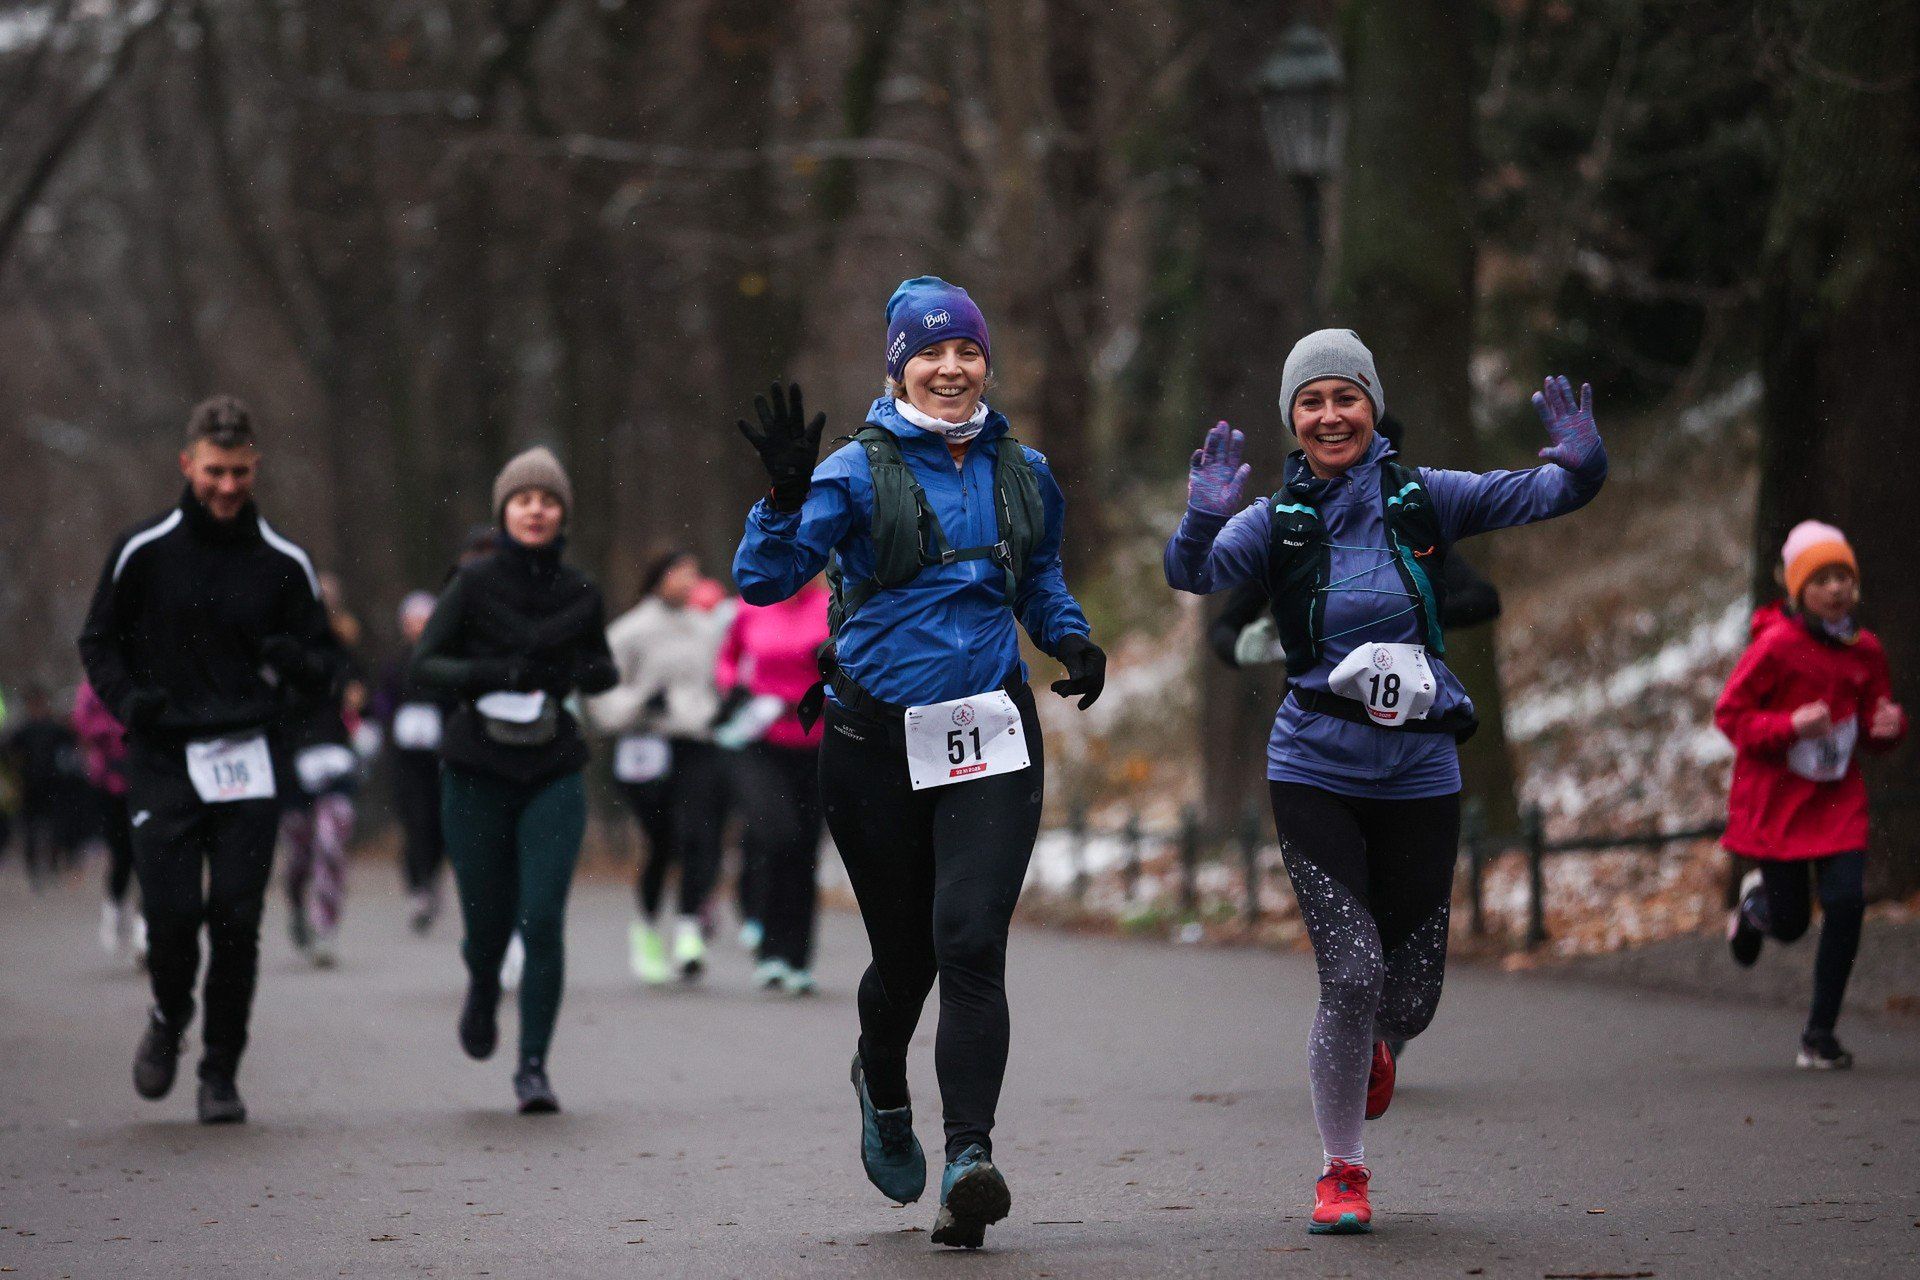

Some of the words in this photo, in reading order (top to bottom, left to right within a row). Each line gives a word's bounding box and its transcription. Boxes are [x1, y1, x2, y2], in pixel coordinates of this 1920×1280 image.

[926, 312, 948, 328] Buff
[888, 331, 906, 361] UTMB
[1370, 673, 1400, 708] 18
[947, 726, 982, 765] 51
